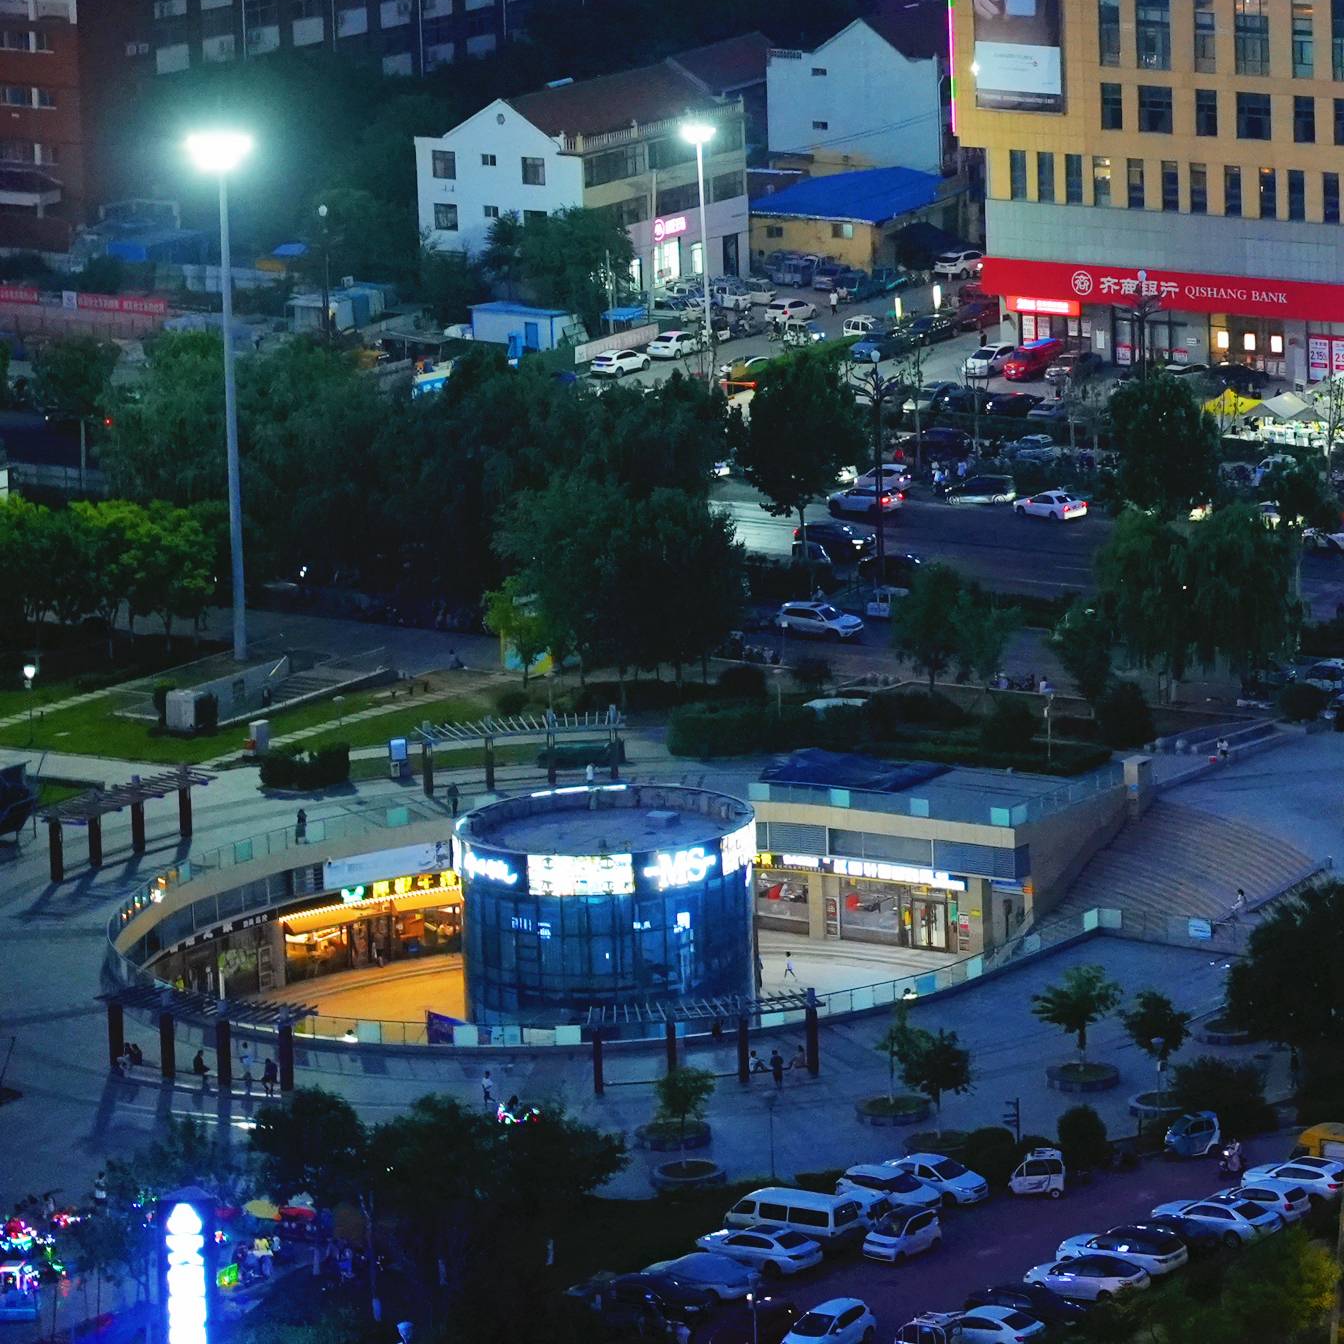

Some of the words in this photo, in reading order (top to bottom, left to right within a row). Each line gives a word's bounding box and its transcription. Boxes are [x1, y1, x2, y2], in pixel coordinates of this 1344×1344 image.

[1099, 276, 1180, 299] 齐商银行
[1184, 284, 1248, 301] QISHANG
[1251, 290, 1288, 304] BANK
